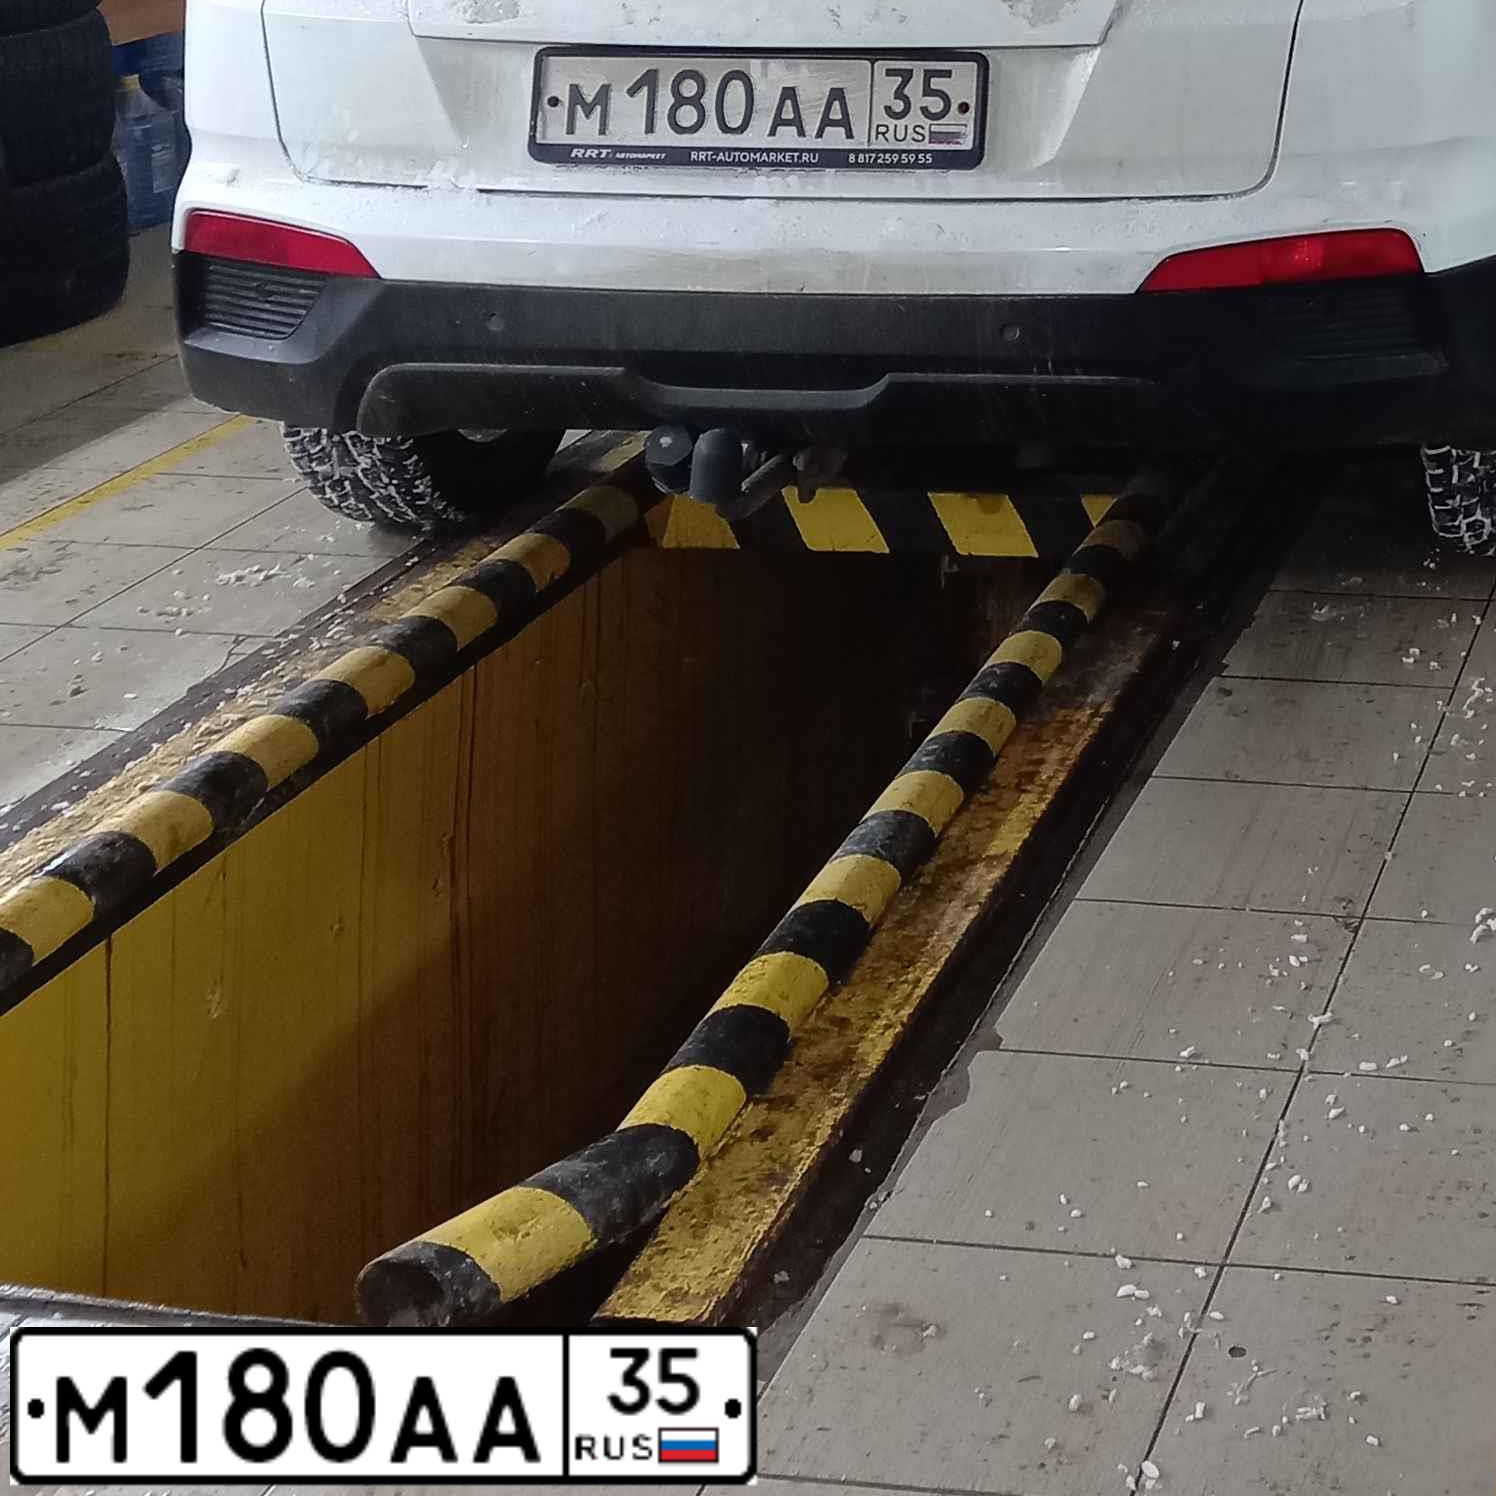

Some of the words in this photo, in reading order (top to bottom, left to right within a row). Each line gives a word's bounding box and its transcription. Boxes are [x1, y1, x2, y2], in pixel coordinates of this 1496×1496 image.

[883, 68, 953, 120] 35
[875, 123, 926, 143] RUS
[570, 148, 612, 159] RRT
[690, 150, 819, 164] RRT-AUTOMARKET.RU
